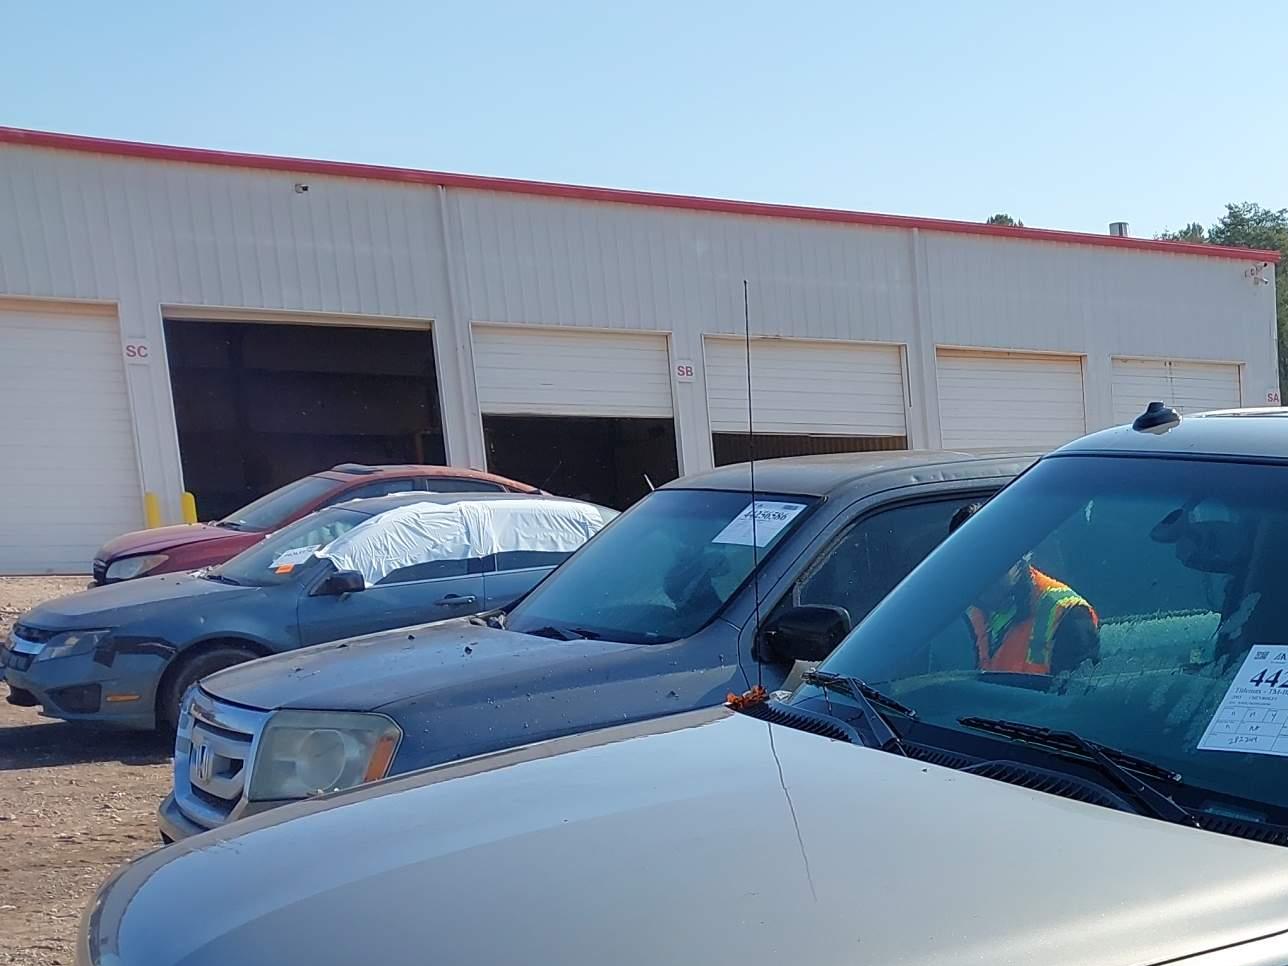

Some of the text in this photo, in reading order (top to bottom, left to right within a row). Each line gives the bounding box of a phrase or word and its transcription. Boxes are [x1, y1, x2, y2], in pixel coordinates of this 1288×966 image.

[126, 344, 148, 358] SC
[677, 365, 694, 377] SB
[1267, 392, 1280, 403] SA
